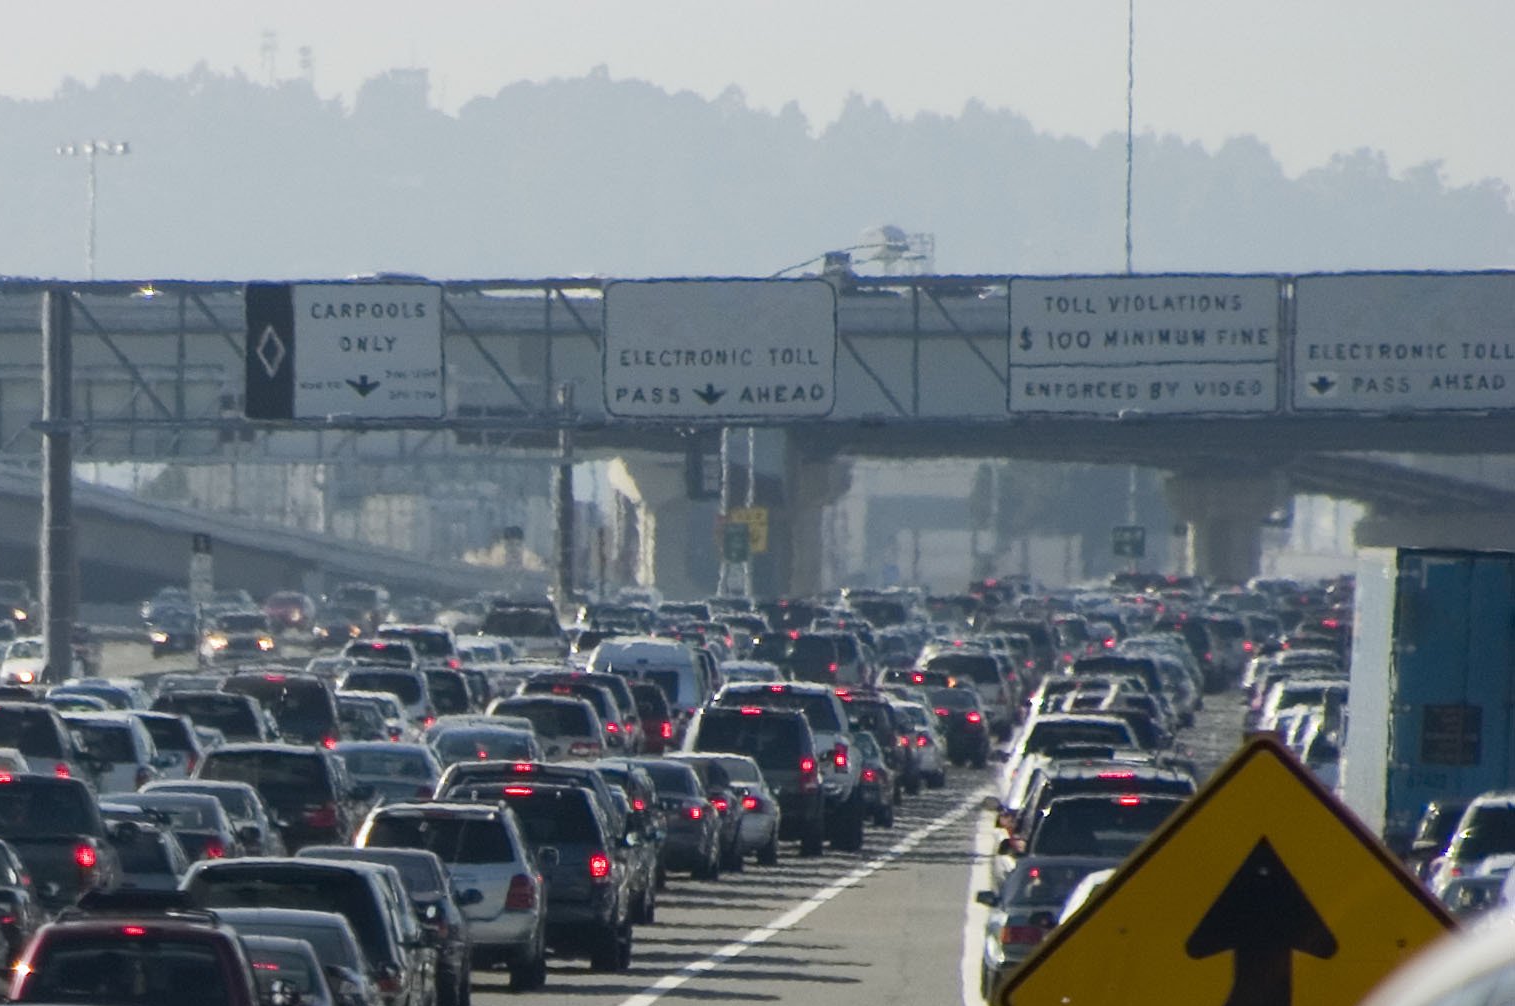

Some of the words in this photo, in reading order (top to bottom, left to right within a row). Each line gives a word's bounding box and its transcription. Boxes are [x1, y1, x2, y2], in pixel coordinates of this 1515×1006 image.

[311, 302, 426, 319] CARPOOLS
[1044, 296, 1097, 314] TOLL
[1107, 295, 1243, 313] VIOLATIONS
[339, 335, 397, 352] ONLY
[1103, 328, 1206, 347] MINIMUM
[1216, 327, 1270, 345] FINE
[620, 348, 754, 367] ELECTRONIC
[768, 348, 819, 366] TOLL
[1308, 343, 1448, 360] ELECTRONIC
[1462, 342, 1515, 360] TOLL
[615, 387, 681, 404] PASS
[739, 383, 825, 403] AHEAD
[1025, 381, 1138, 399] ENFORCED
[1150, 381, 1180, 399] BY
[1193, 380, 1263, 397] VIDEO
[1352, 376, 1411, 394] PASS
[1430, 374, 1506, 391] AHEAD
